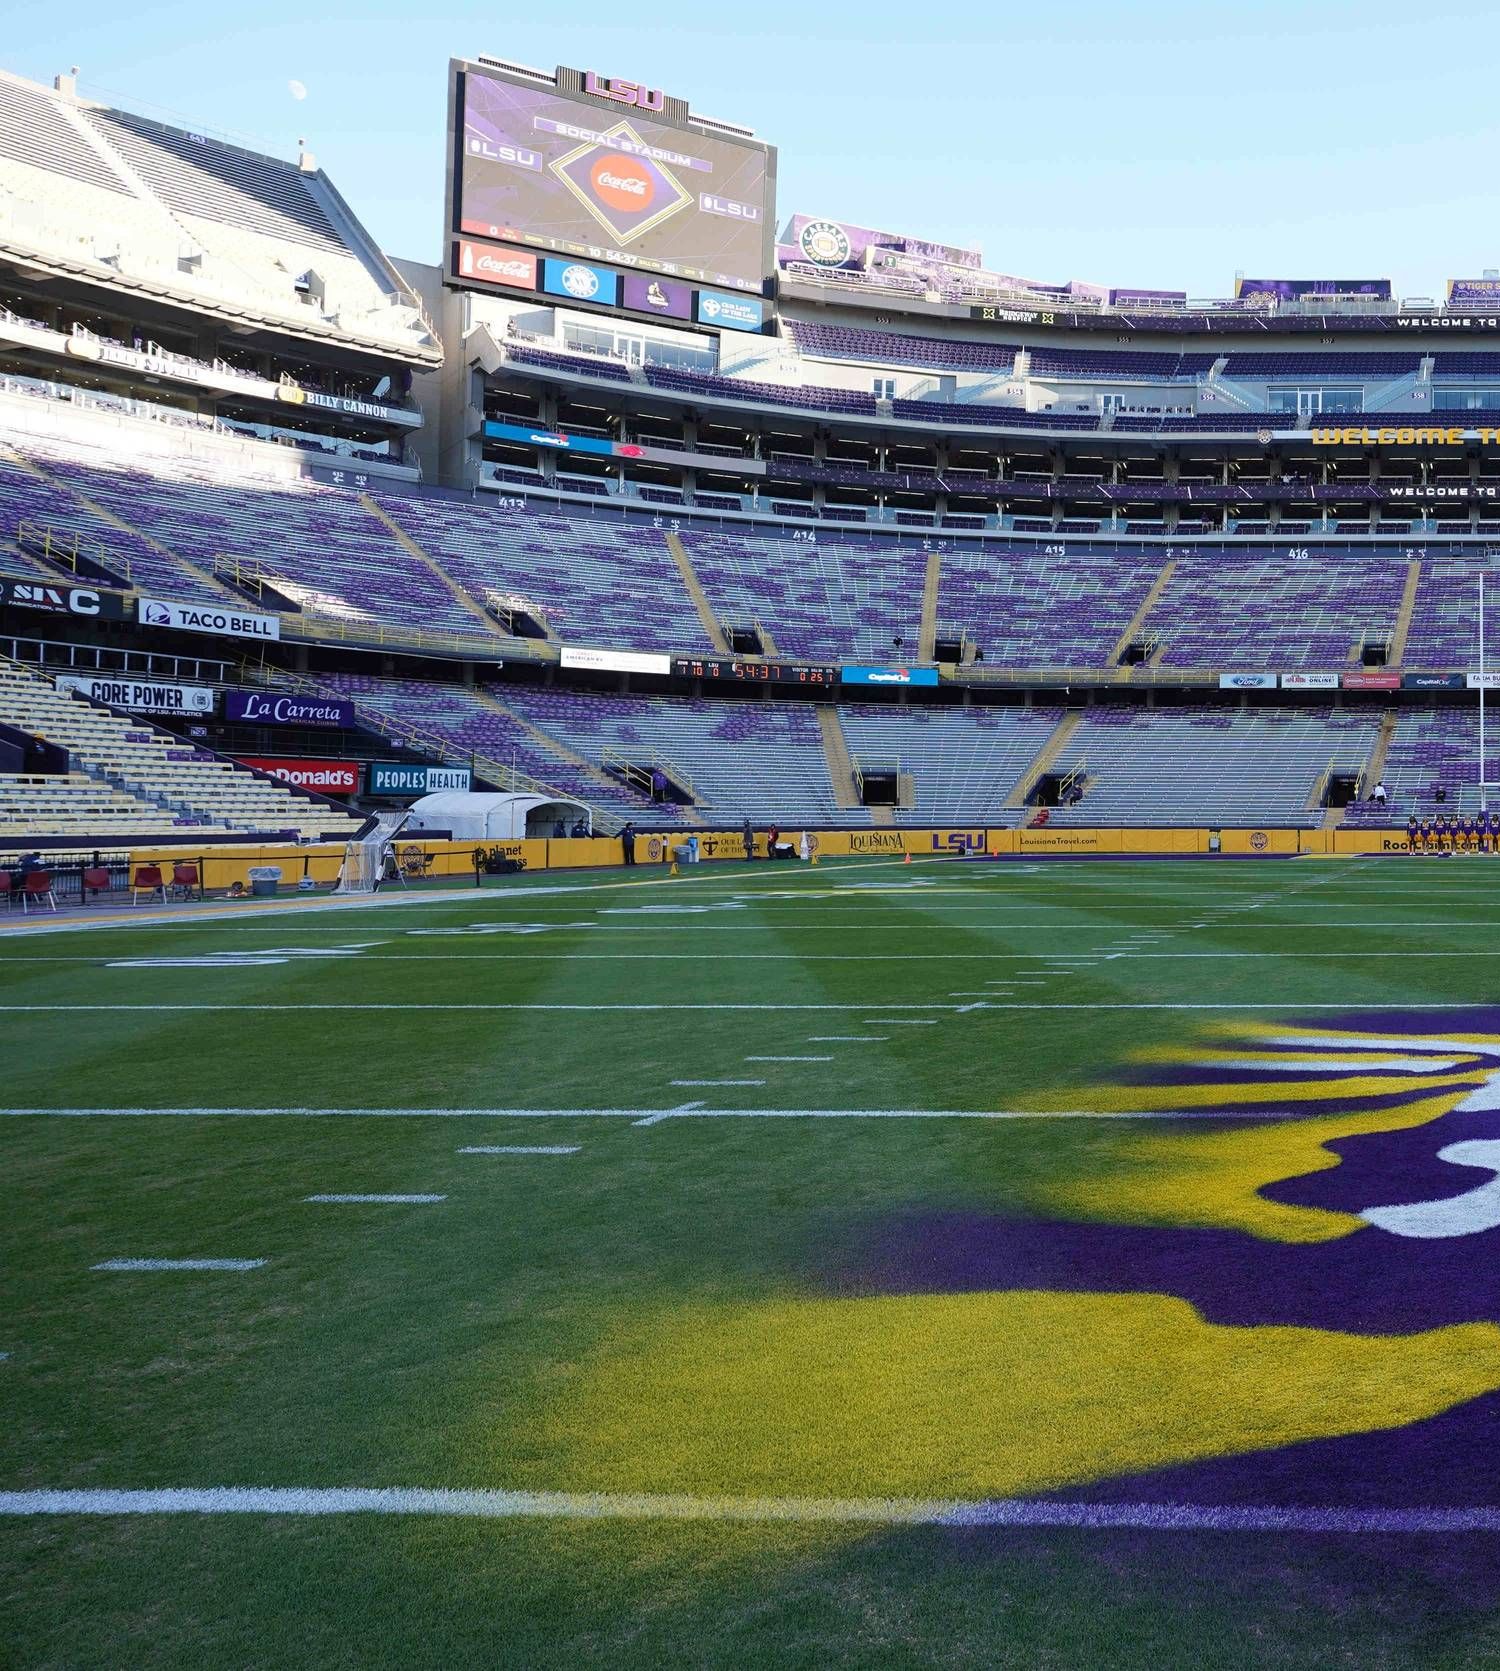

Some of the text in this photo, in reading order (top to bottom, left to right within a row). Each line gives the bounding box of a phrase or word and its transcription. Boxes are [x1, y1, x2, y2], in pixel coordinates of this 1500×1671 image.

[585, 71, 664, 112] LSU
[482, 142, 535, 166] LSU
[556, 124, 692, 167] SOCIAL STADIUM
[597, 172, 648, 196] Coca-Cola
[712, 202, 757, 220] LSU
[802, 222, 848, 249] CAESARS
[477, 255, 531, 279] Coca-Cola
[550, 239, 556, 249] 1
[588, 246, 601, 257] 10
[606, 251, 637, 265] 54:37
[699, 271, 705, 280] 1
[1466, 282, 1493, 290] TIGER
[999, 309, 1038, 318] BRIDGEWAY
[1397, 318, 1471, 327] WELCOME
[1478, 318, 1497, 327] TO
[307, 391, 338, 408] BILLY
[344, 399, 387, 418] CANNON
[1312, 428, 1465, 445] WELCOME
[1390, 487, 1468, 496] WELCOME
[1477, 487, 1496, 496] TO
[499, 498, 525, 509] 413
[793, 531, 816, 543] 414
[1045, 546, 1065, 556] 415
[1288, 549, 1308, 559] 416
[179, 609, 272, 636] TACO BELL
[693, 663, 823, 682] 10 0 54:37 0 25
[91, 682, 183, 708] CORE POWER
[241, 693, 341, 721] La Carreta
[376, 770, 468, 789] PEOPLES HEALTH
[933, 833, 985, 850] LSU
[1020, 836, 1097, 846] LouisianaTravel.com
[489, 845, 522, 858] planet
